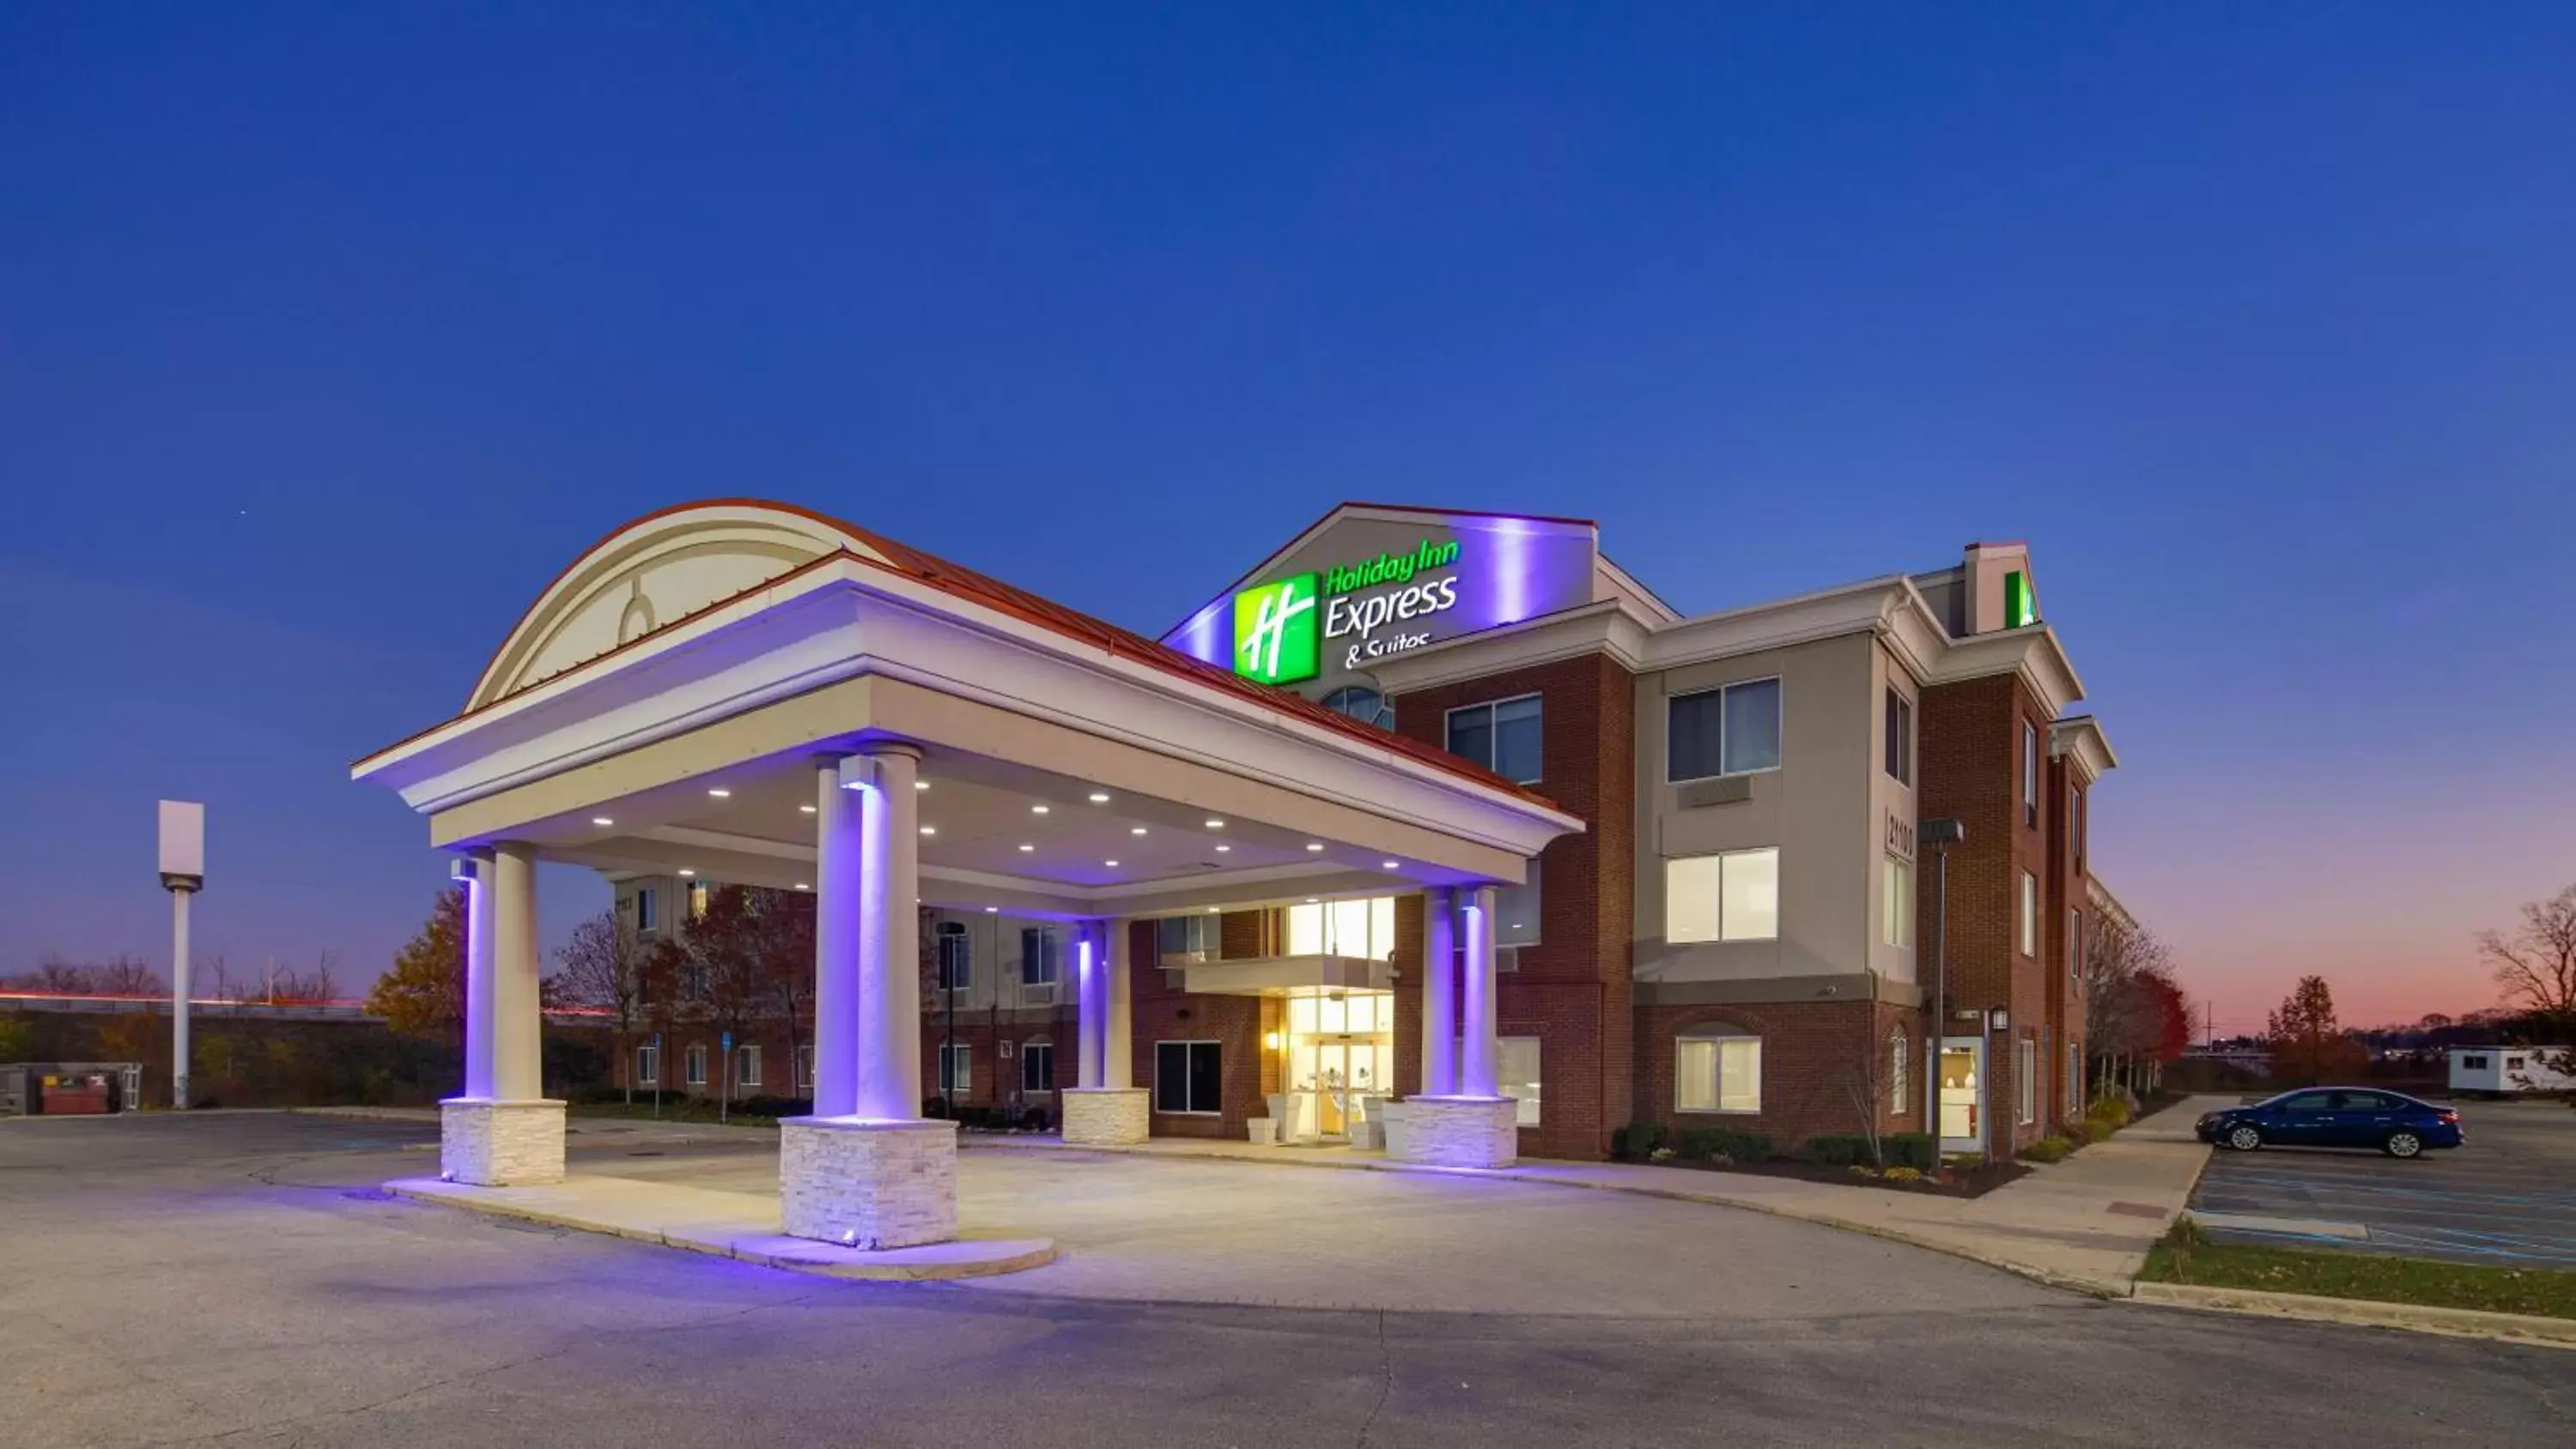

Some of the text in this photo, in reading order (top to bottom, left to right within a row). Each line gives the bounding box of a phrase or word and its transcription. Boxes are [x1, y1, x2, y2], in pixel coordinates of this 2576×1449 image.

[1326, 539, 1458, 595] Holiday Inn
[1325, 576, 1457, 638] Express
